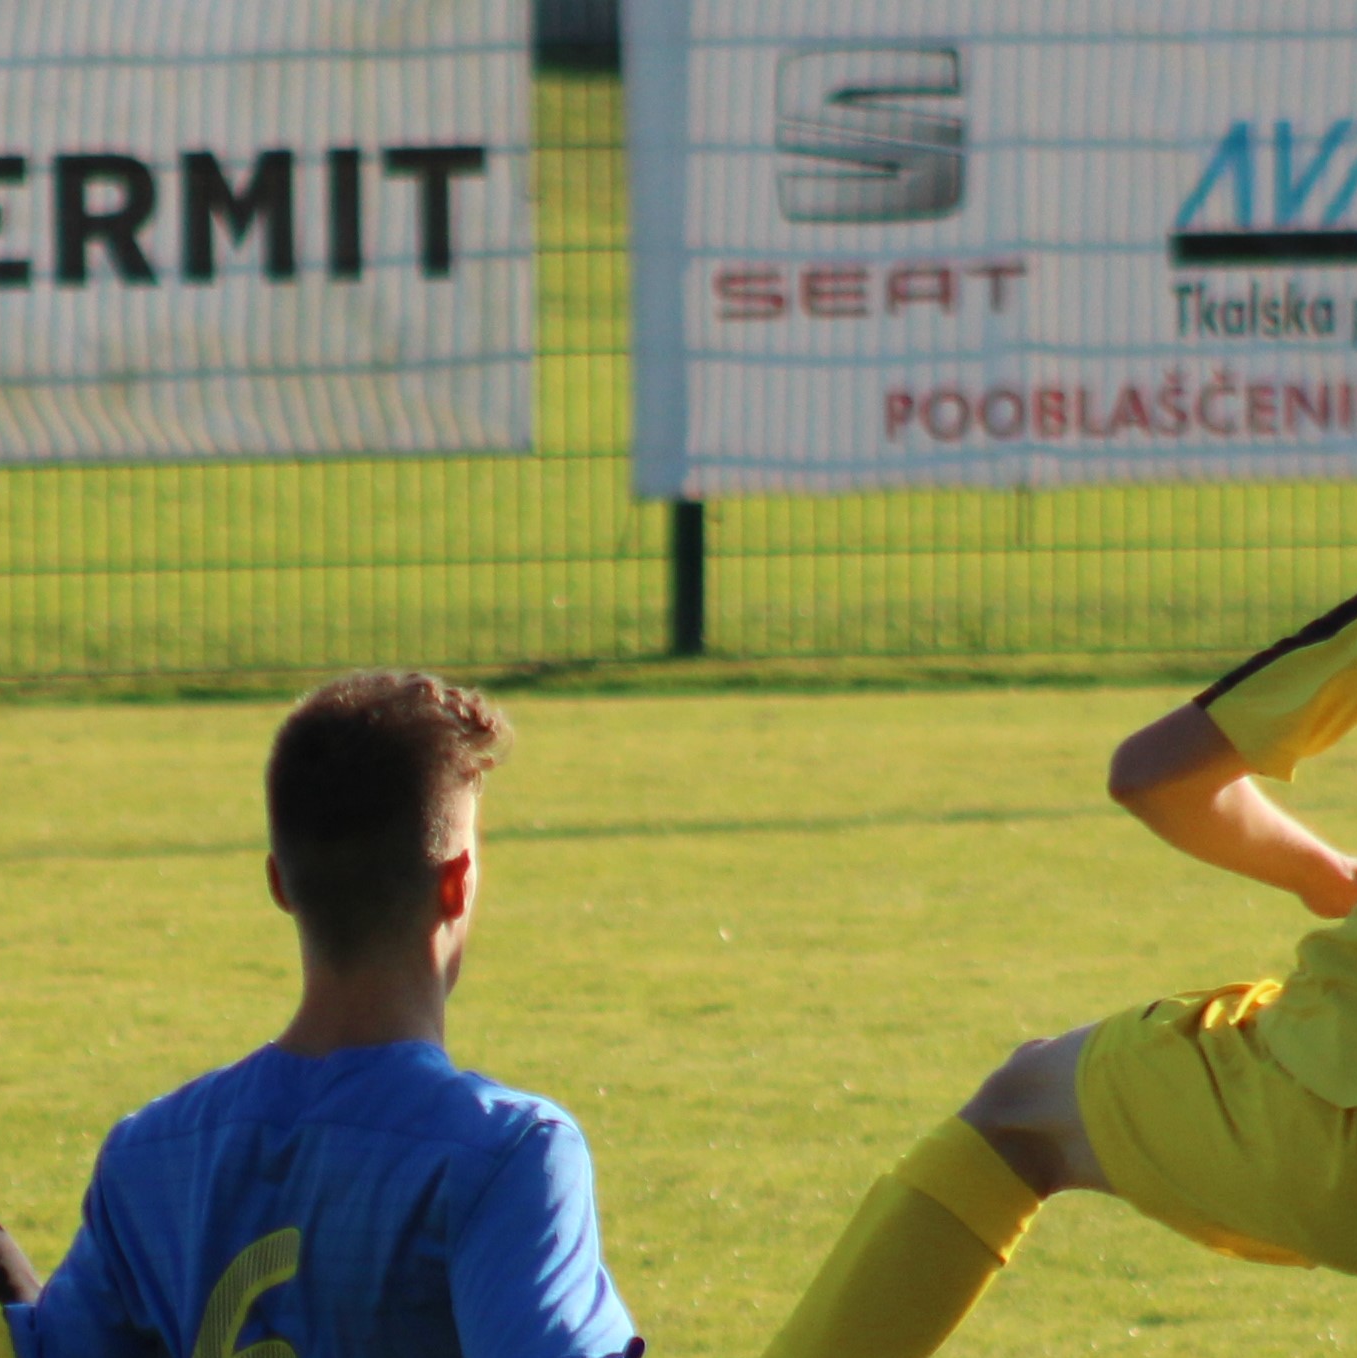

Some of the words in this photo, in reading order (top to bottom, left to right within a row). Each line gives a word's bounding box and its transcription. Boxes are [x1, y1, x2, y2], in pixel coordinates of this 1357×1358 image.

[713, 260, 1029, 321] SEAT
[1172, 283, 1336, 338] Tkalska
[884, 366, 1354, 442] POOBLAŠČENI
